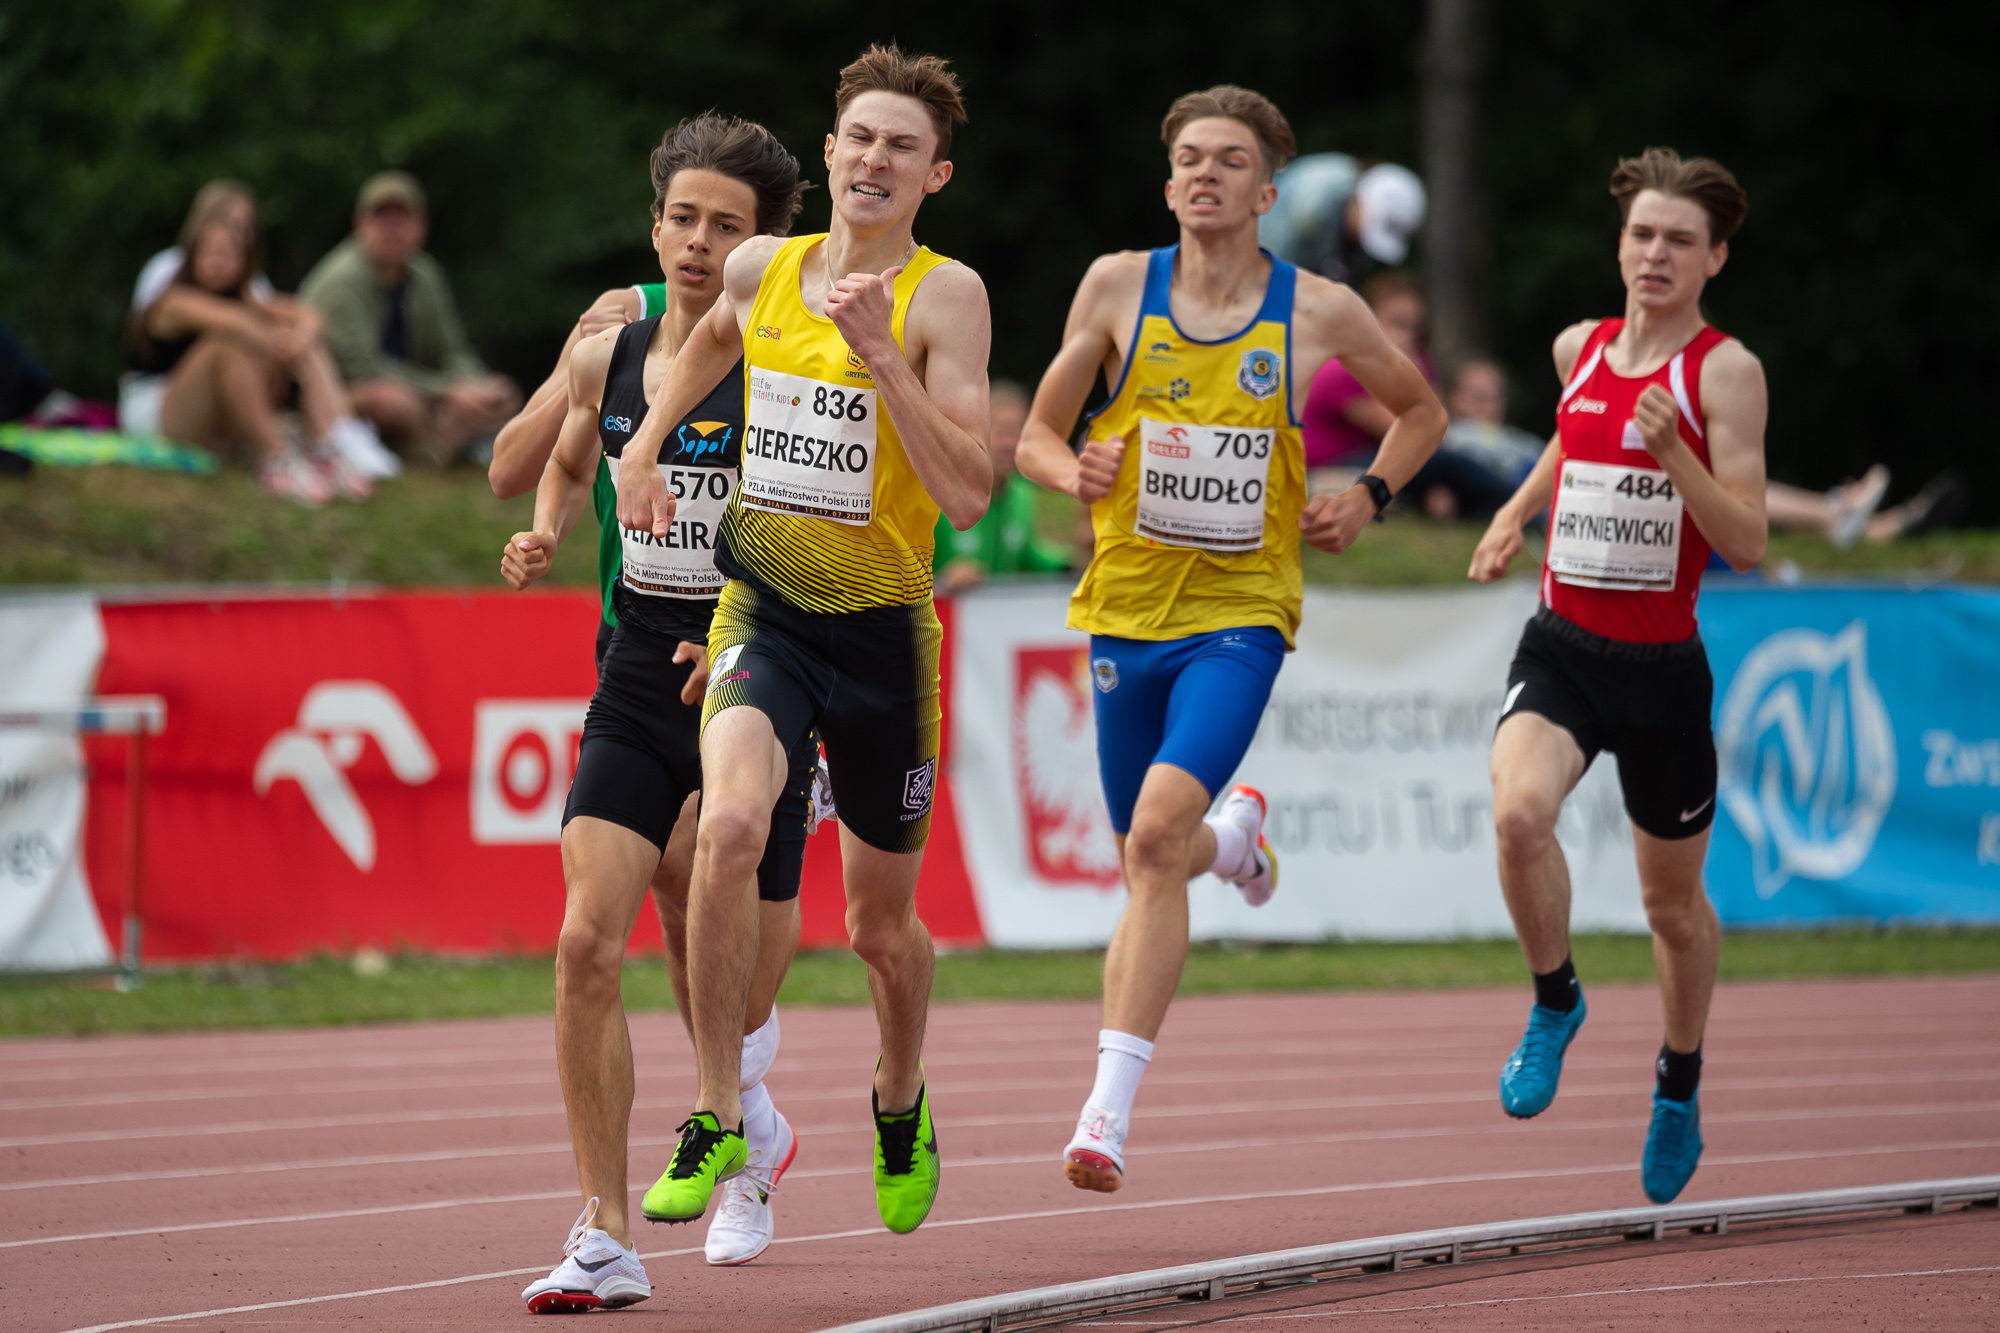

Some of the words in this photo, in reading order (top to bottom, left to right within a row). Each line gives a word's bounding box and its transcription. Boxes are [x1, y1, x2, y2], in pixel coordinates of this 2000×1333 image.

[776, 393, 790, 405] KIDS
[813, 386, 867, 422] 836
[676, 424, 733, 464] Sopot
[746, 424, 868, 473] CIERESZKO
[1149, 442, 1188, 458] ORLEN
[1214, 432, 1269, 460] 703
[669, 470, 729, 501] 570
[748, 481, 766, 494] PZLA
[767, 485, 819, 503] Mistrzostwa
[822, 494, 849, 508] Polski
[852, 498, 871, 509] U18
[776, 479, 801, 490] Olimpiada
[1146, 469, 1262, 505] BRUDŁO
[1615, 474, 1674, 502] 484
[804, 506, 868, 520] 15-17.07.2022
[1556, 512, 1674, 547] HRYNIEWICKI
[642, 569, 689, 583] Mistrzostwa
[692, 572, 721, 583] Polski
